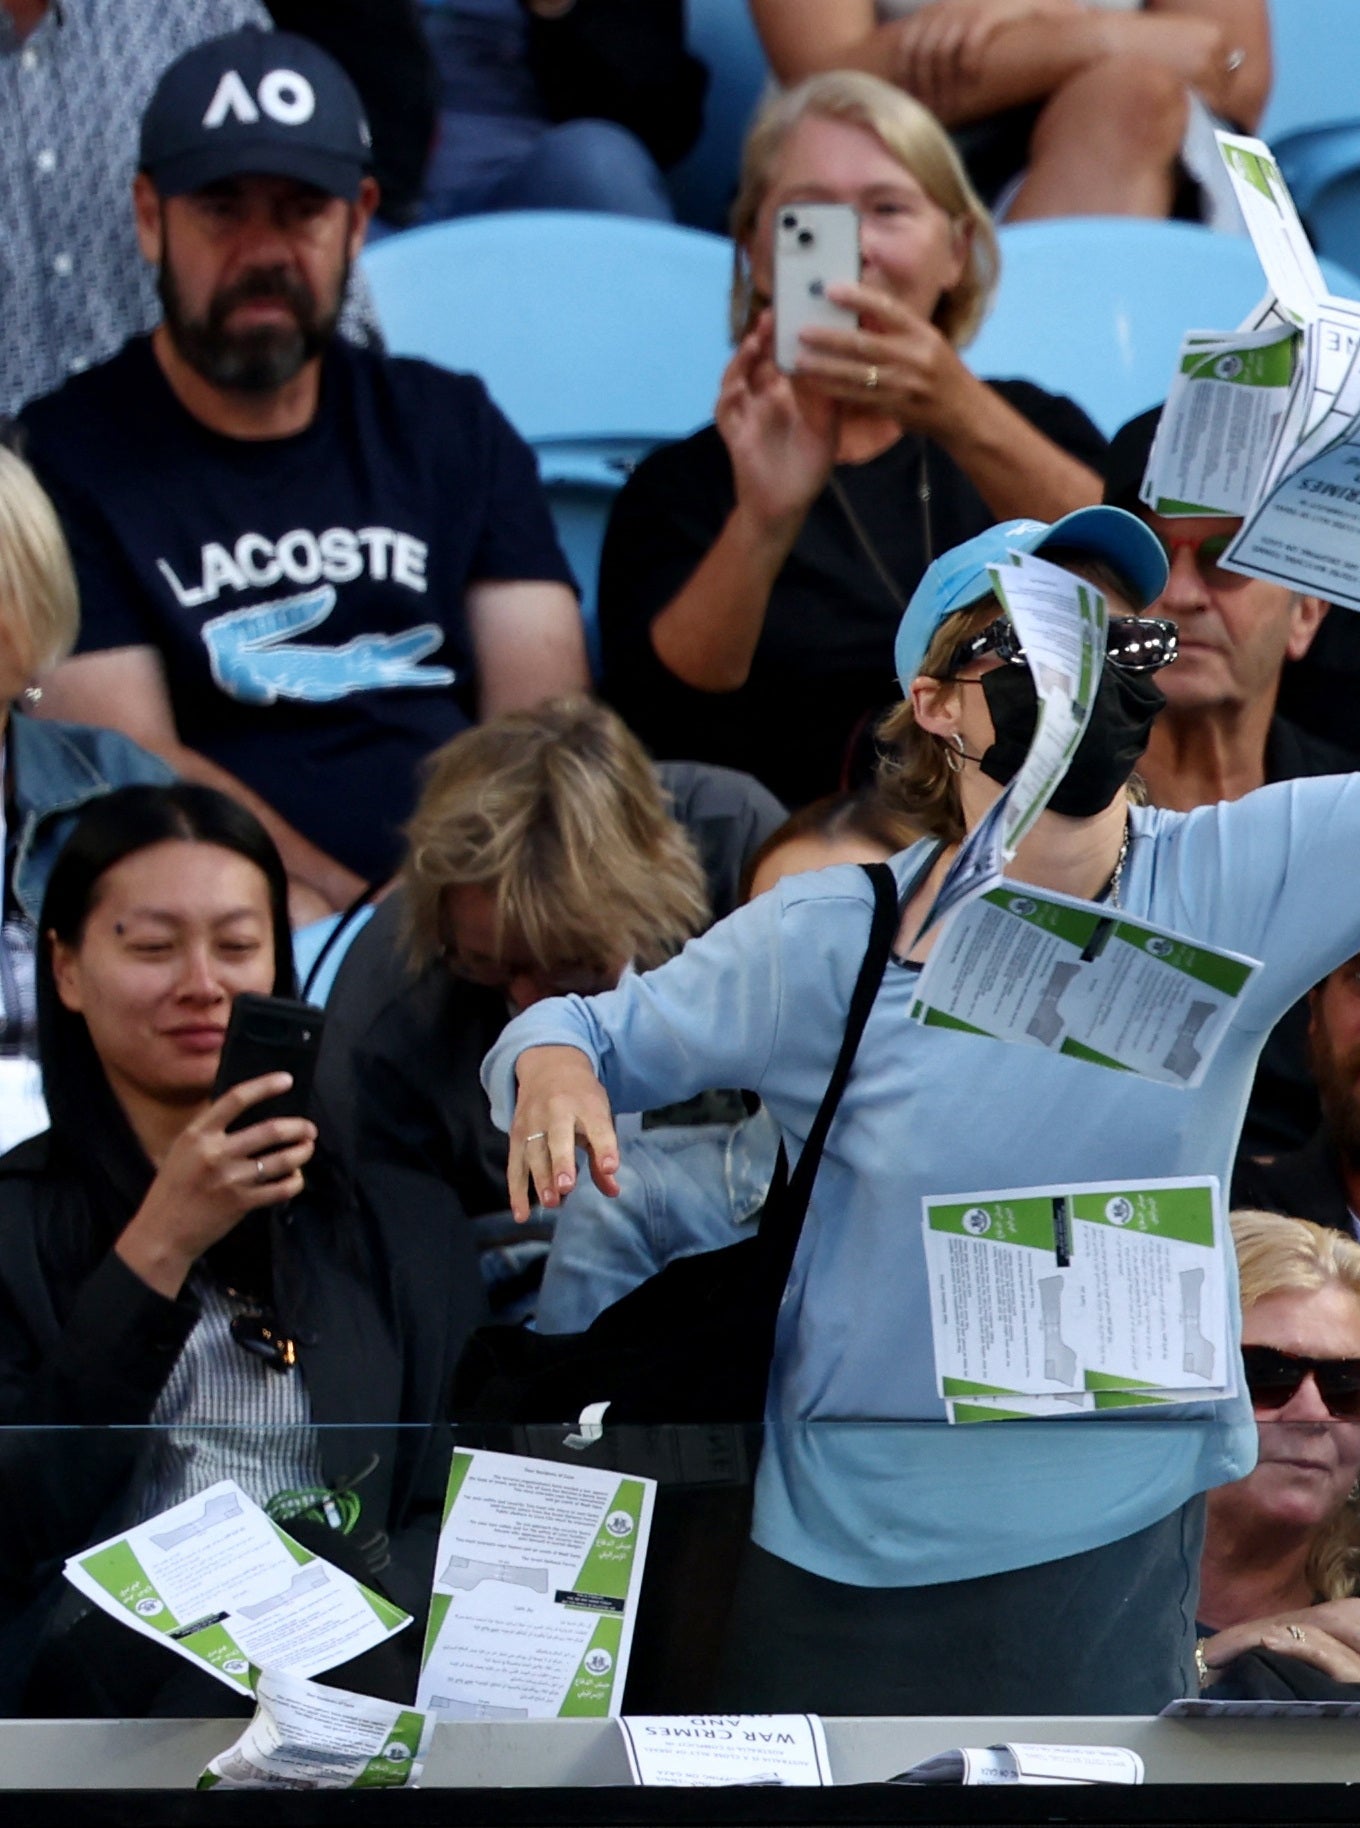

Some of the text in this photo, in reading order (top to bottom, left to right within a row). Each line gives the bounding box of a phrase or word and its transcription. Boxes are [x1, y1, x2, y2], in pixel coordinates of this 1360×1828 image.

[201, 68, 316, 129] AO
[156, 526, 428, 607] LACOSTE
[645, 1726, 795, 1744] WAR CRIMES
[691, 1719, 740, 1727] AND
